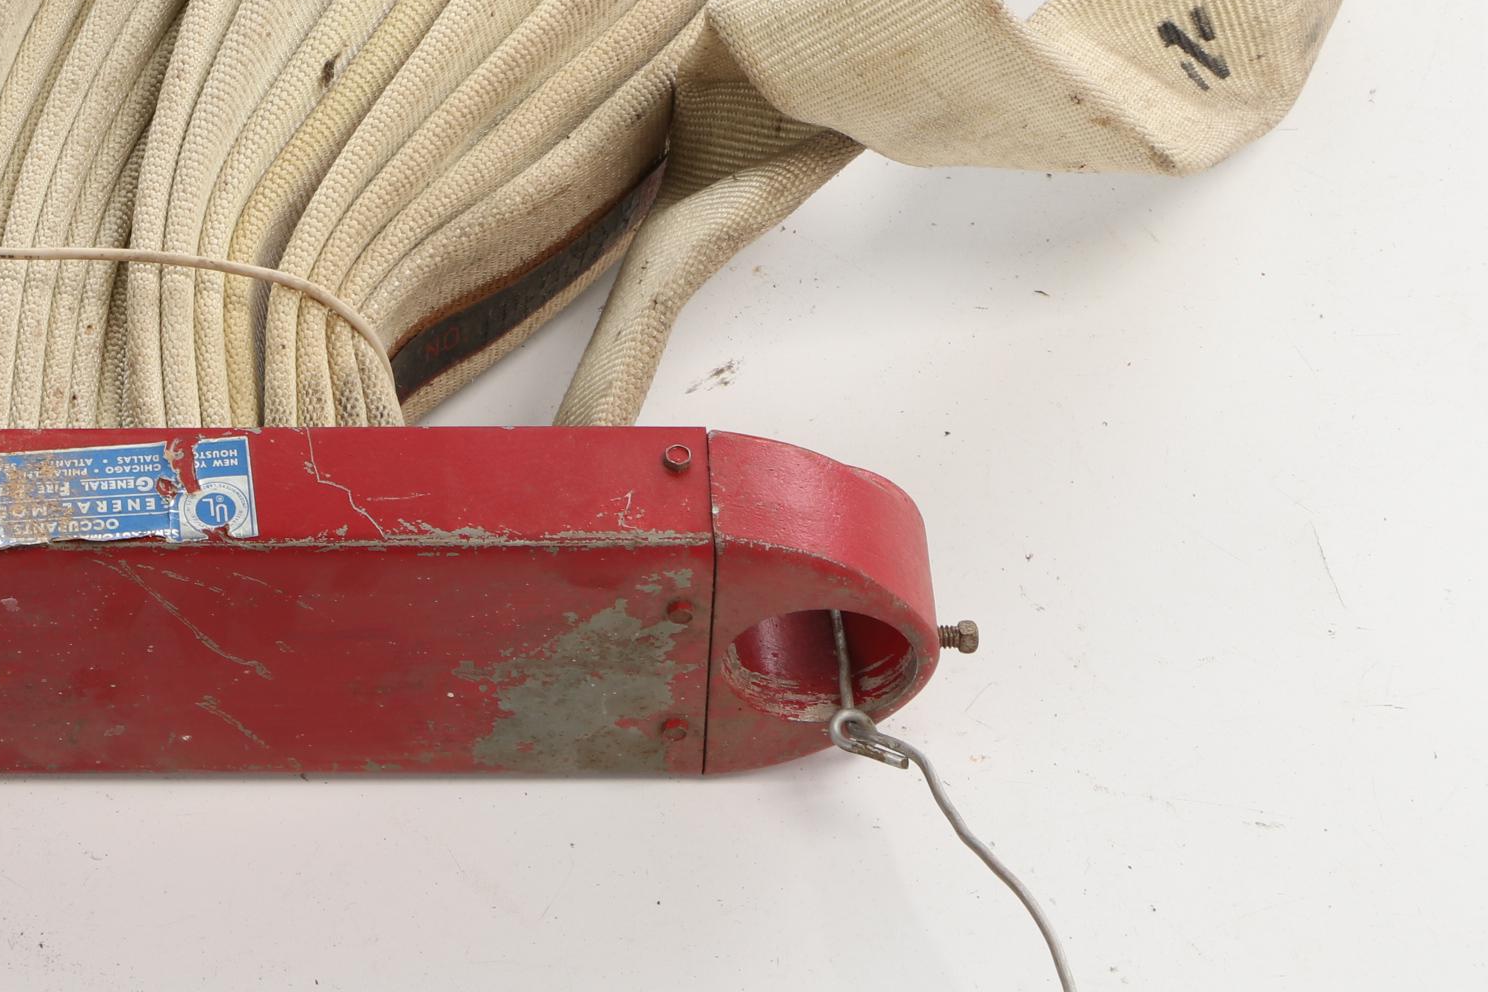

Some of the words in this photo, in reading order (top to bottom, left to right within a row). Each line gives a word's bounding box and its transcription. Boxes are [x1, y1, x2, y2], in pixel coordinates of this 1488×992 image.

[116, 454, 160, 464] DALLAS
[213, 458, 238, 467] NEW
[105, 463, 161, 474] CHICAGO
[202, 498, 228, 522] UL
